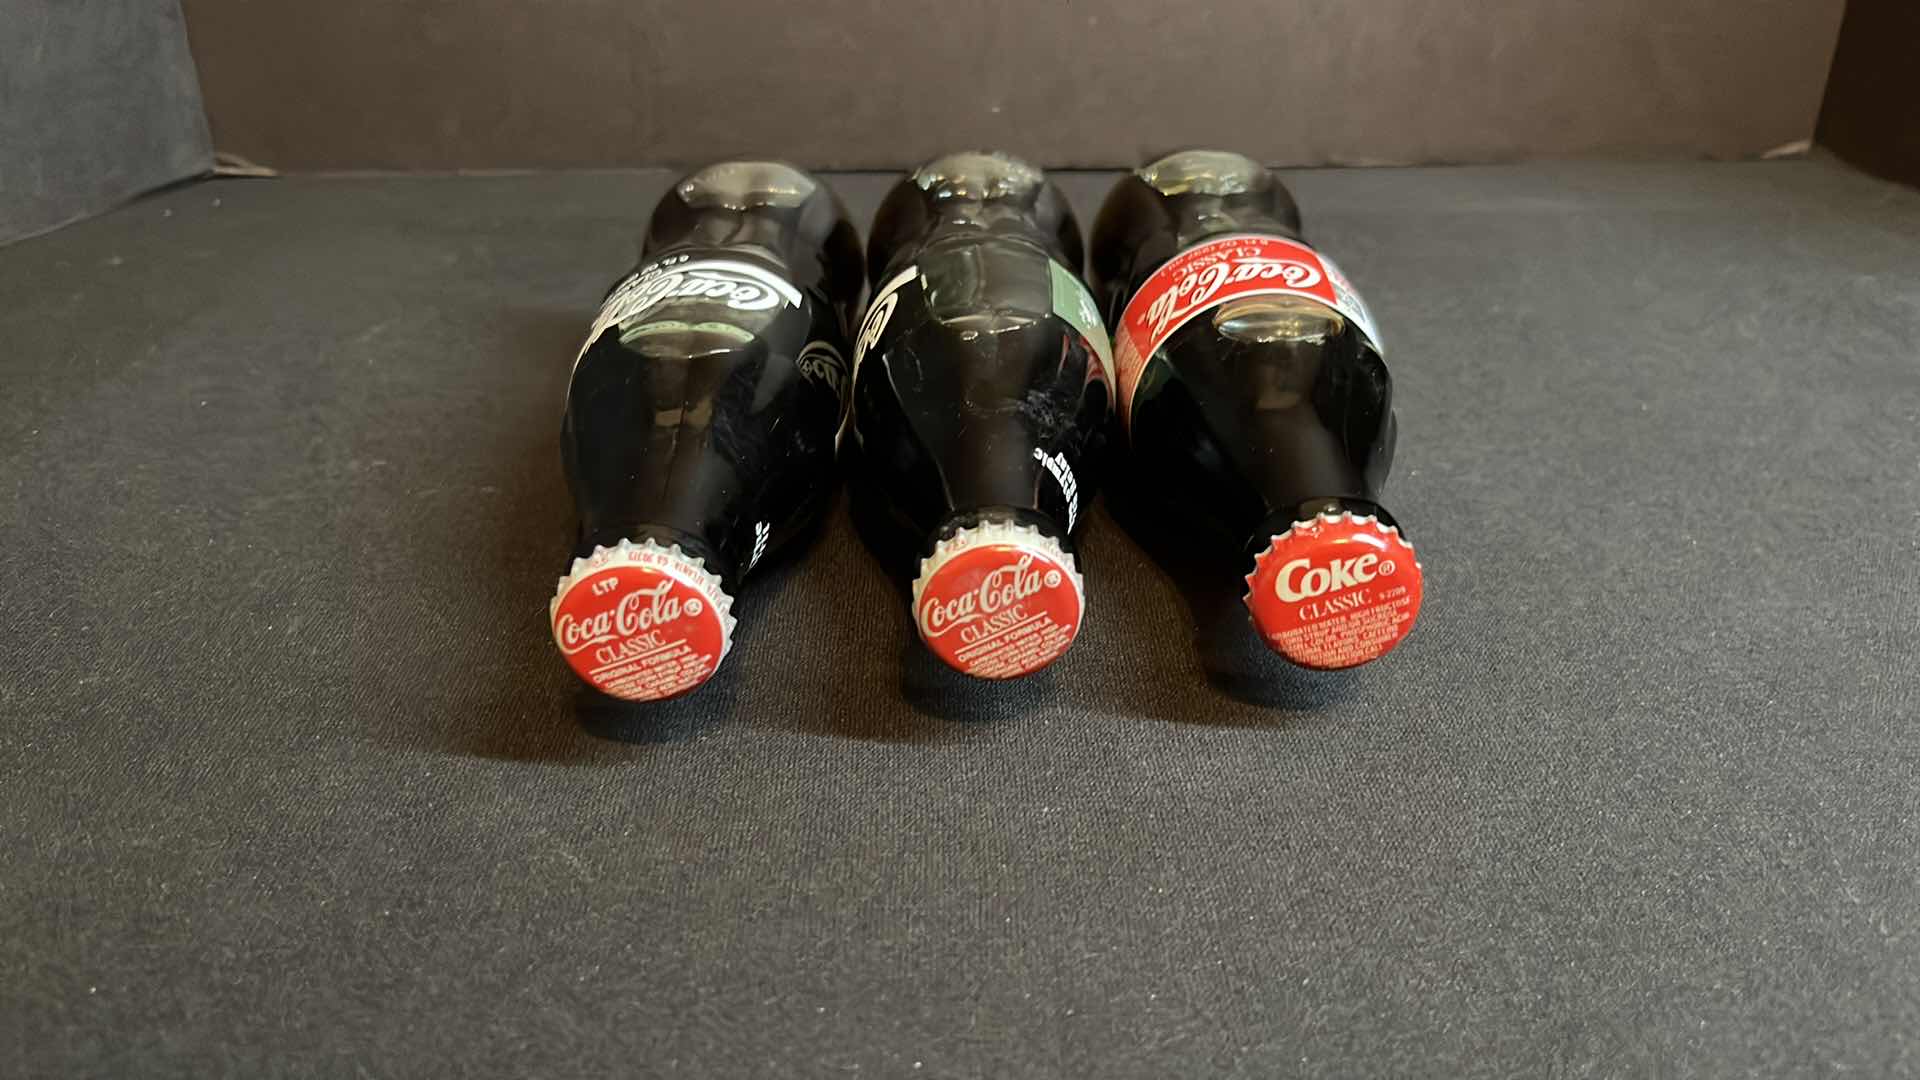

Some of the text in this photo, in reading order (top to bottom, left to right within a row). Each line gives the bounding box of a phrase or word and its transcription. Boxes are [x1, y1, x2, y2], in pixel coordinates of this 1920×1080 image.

[1171, 246, 1262, 282] CLASSIC
[1146, 257, 1321, 344] Coca-Cola
[592, 577, 619, 596] LTP
[920, 554, 1044, 638] Coca-Cola
[1275, 553, 1379, 603] Coke
[556, 578, 682, 655] Coca-Cola
[961, 604, 1028, 643] CLASSIC
[1299, 588, 1372, 621] CLASSIC
[596, 630, 666, 664] CLASSIC
